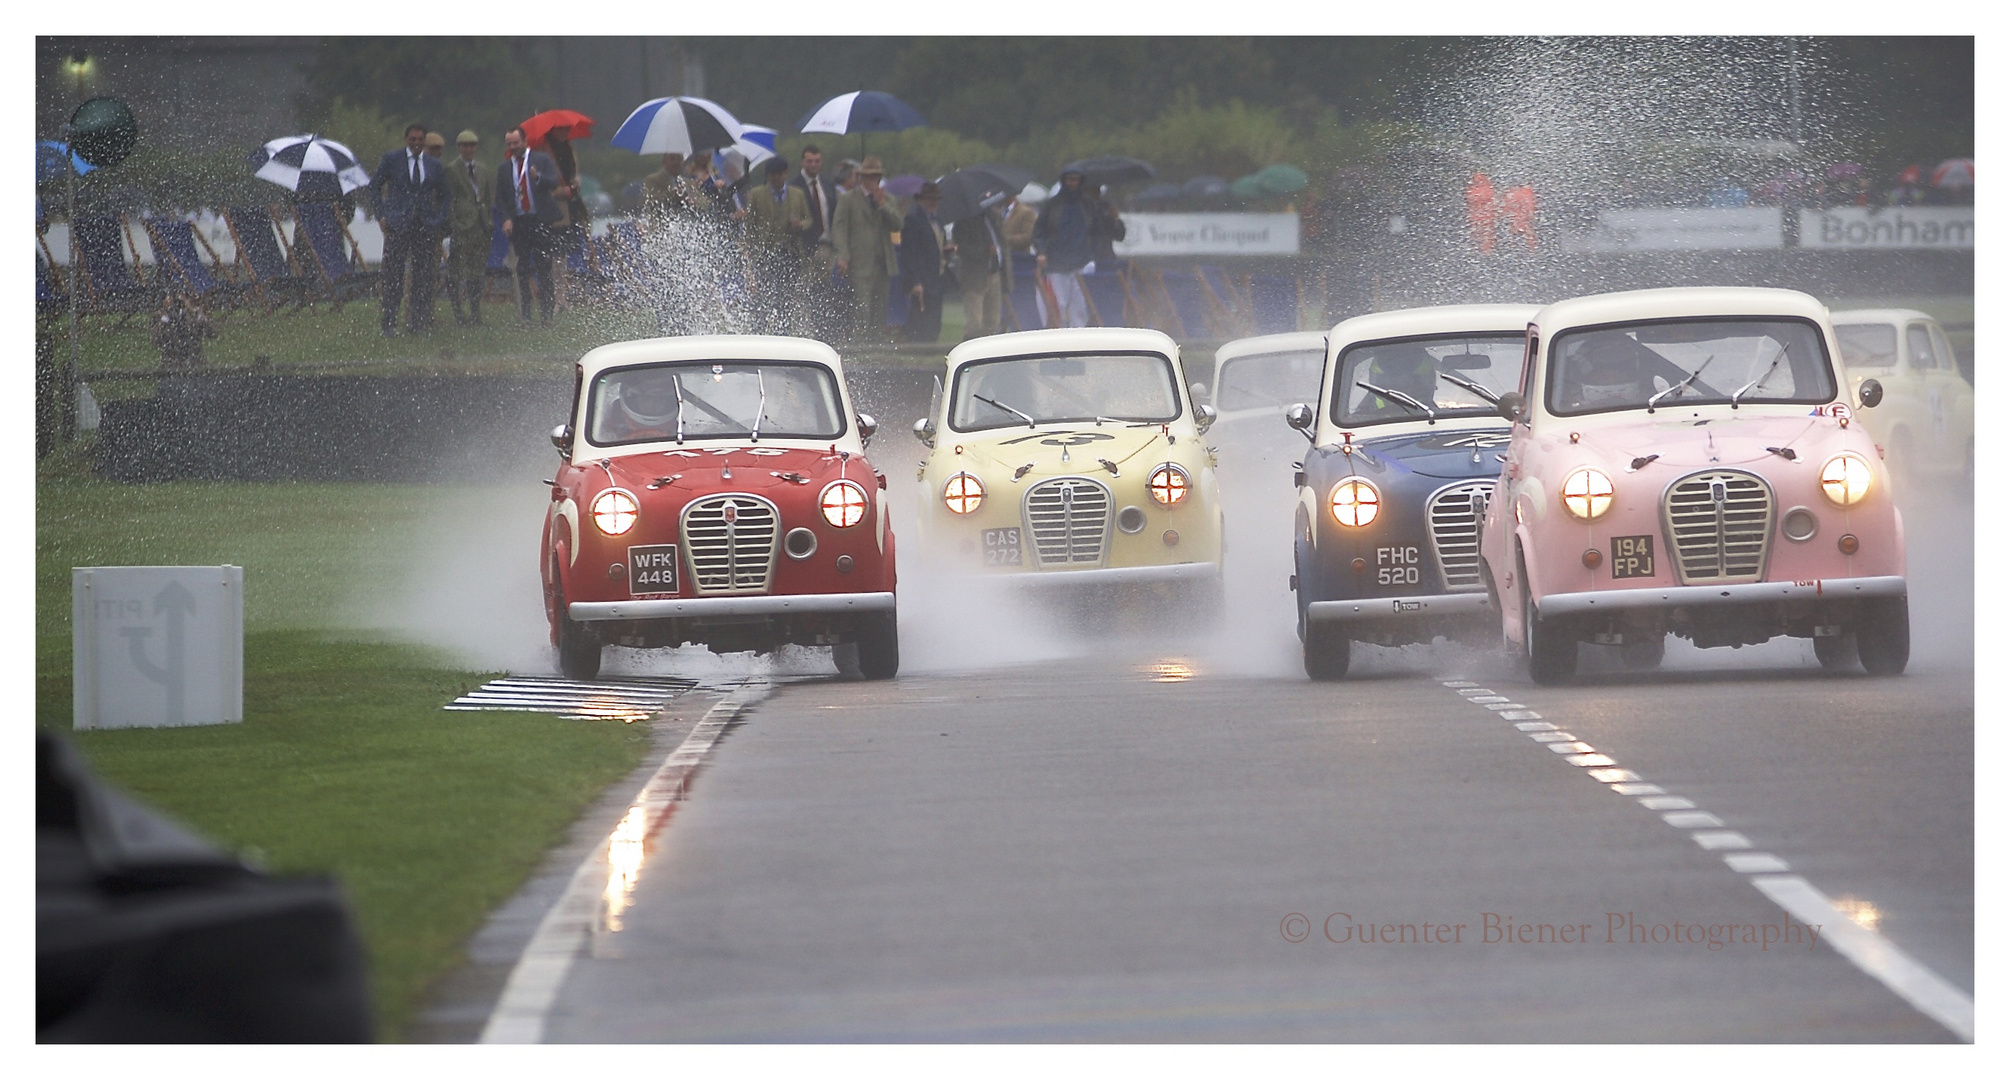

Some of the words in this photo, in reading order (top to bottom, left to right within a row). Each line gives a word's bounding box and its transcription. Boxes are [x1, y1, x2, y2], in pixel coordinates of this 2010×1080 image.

[986, 530, 1018, 546] CAS
[987, 548, 1019, 564] 272
[1377, 546, 1418, 565] FHC
[1616, 538, 1648, 557] 194
[635, 553, 671, 568] WFK
[1614, 556, 1652, 576] FPJ
[637, 570, 672, 585] 448
[1378, 567, 1419, 585] 520
